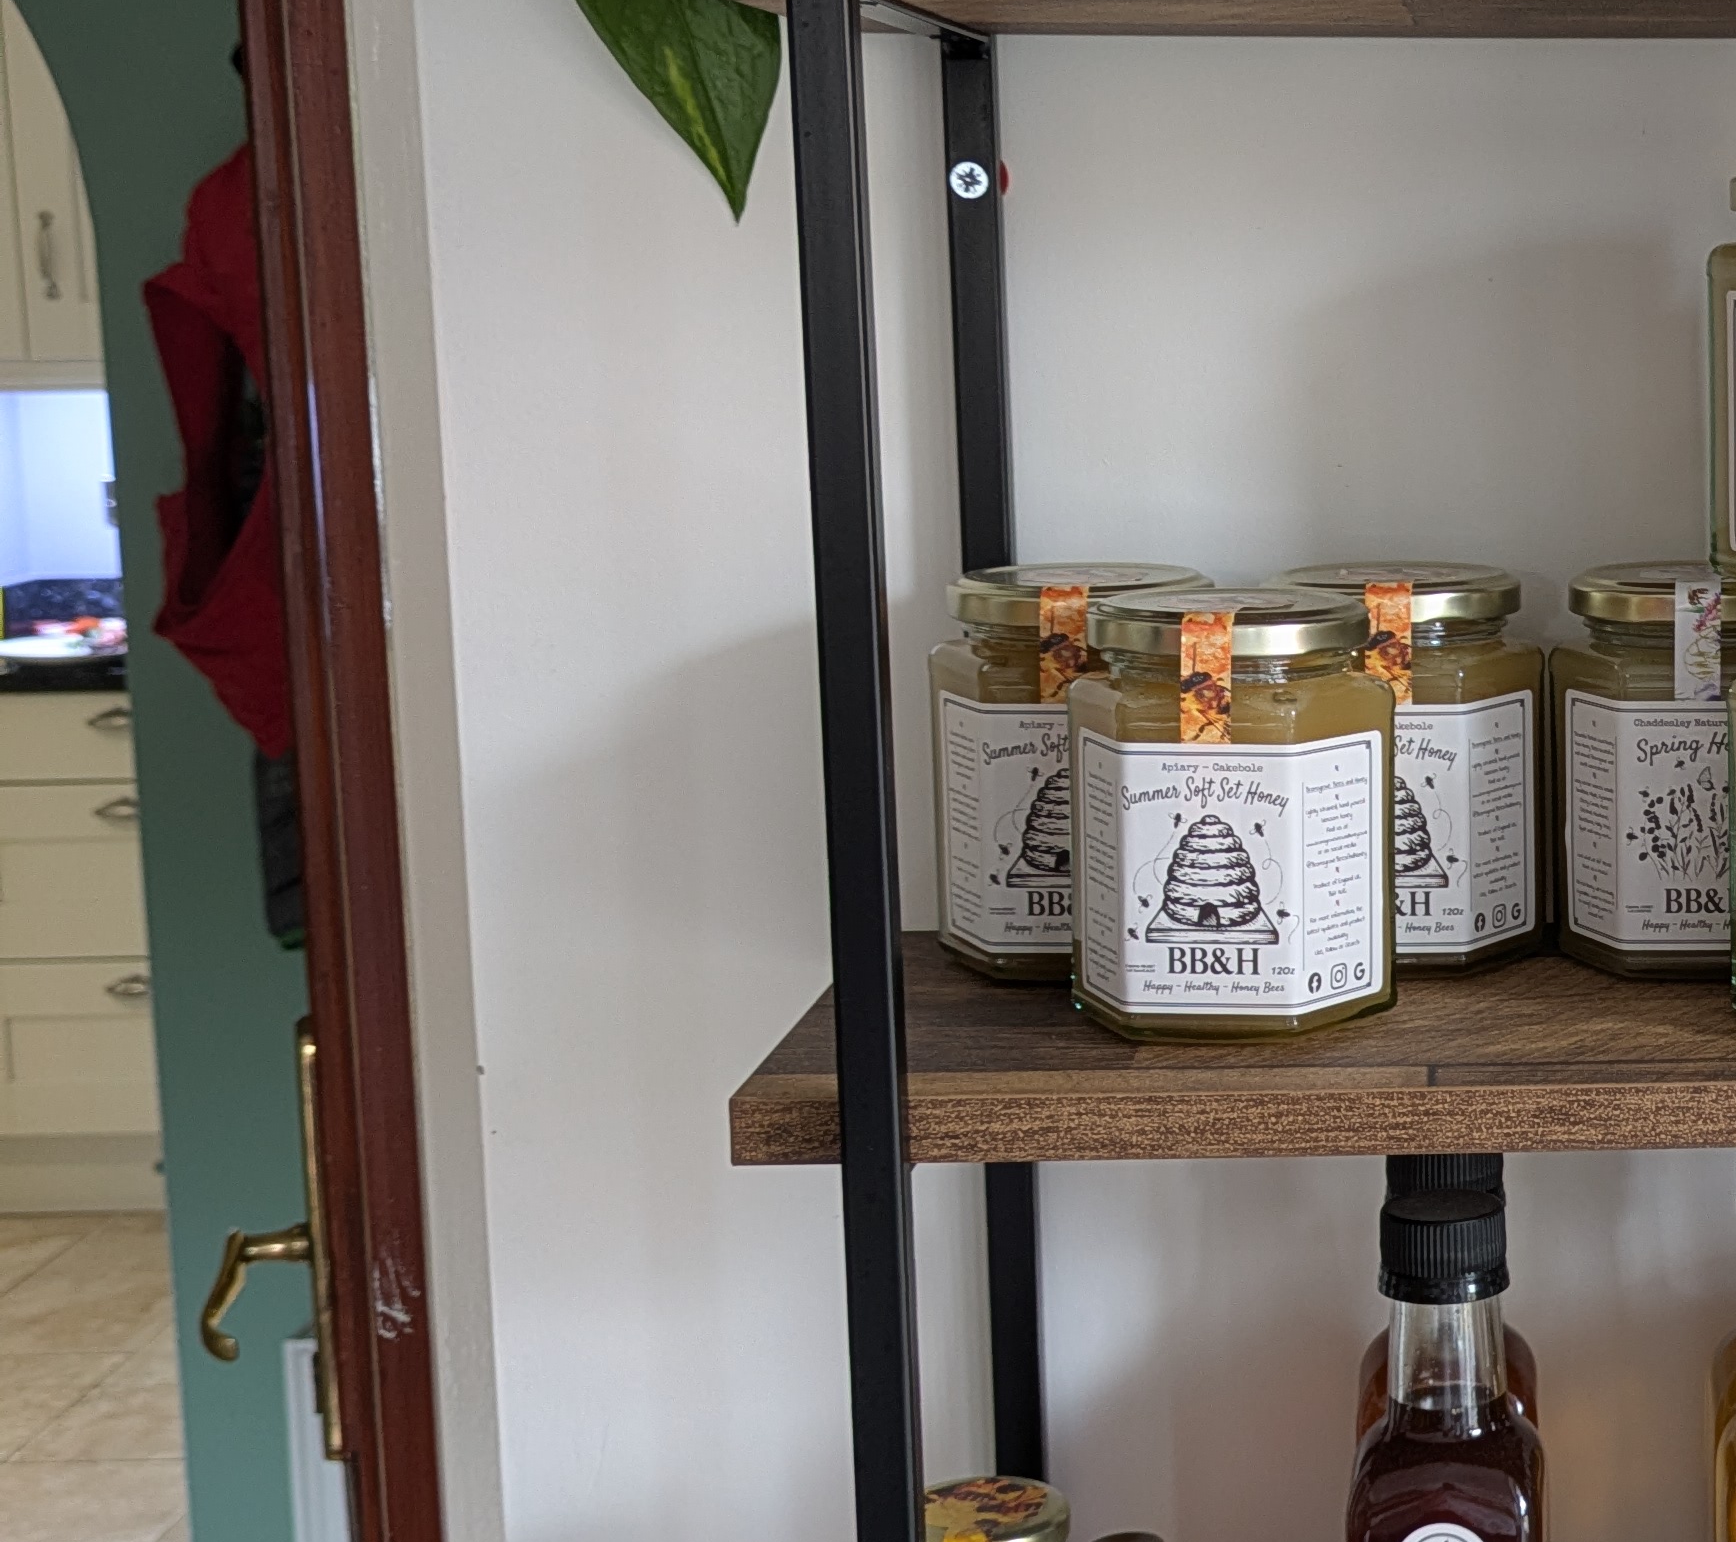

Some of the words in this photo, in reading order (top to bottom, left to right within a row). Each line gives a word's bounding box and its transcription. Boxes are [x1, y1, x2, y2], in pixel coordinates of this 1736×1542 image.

[1395, 722, 1434, 730] kebole
[1633, 718, 1692, 729] Chaddesley
[1694, 718, 1729, 727] Nature
[982, 740, 1038, 766] Summer
[1040, 732, 1070, 763] Soft
[1415, 737, 1458, 771] Honey
[1636, 735, 1704, 767] Spring
[1161, 763, 1199, 773] Apiary
[1212, 762, 1264, 772] Cakebole
[1121, 785, 1181, 810] Summer
[1183, 776, 1217, 809] Soft
[1217, 777, 1244, 803] Set
[1243, 780, 1290, 817] Honey
[1026, 890, 1073, 917] BB
[1664, 887, 1730, 914] BB&
[1004, 921, 1033, 936] Happy
[1405, 921, 1431, 936] Honey
[1434, 921, 1455, 932] Bees
[1642, 919, 1670, 932] Happy
[1680, 919, 1713, 932] Healthy
[1167, 946, 1261, 976] BB&H
[1143, 980, 1174, 995] Happy
[1183, 980, 1220, 996] Healthy
[1230, 981, 1260, 996] Honey
[1262, 981, 1285, 993] Bees
